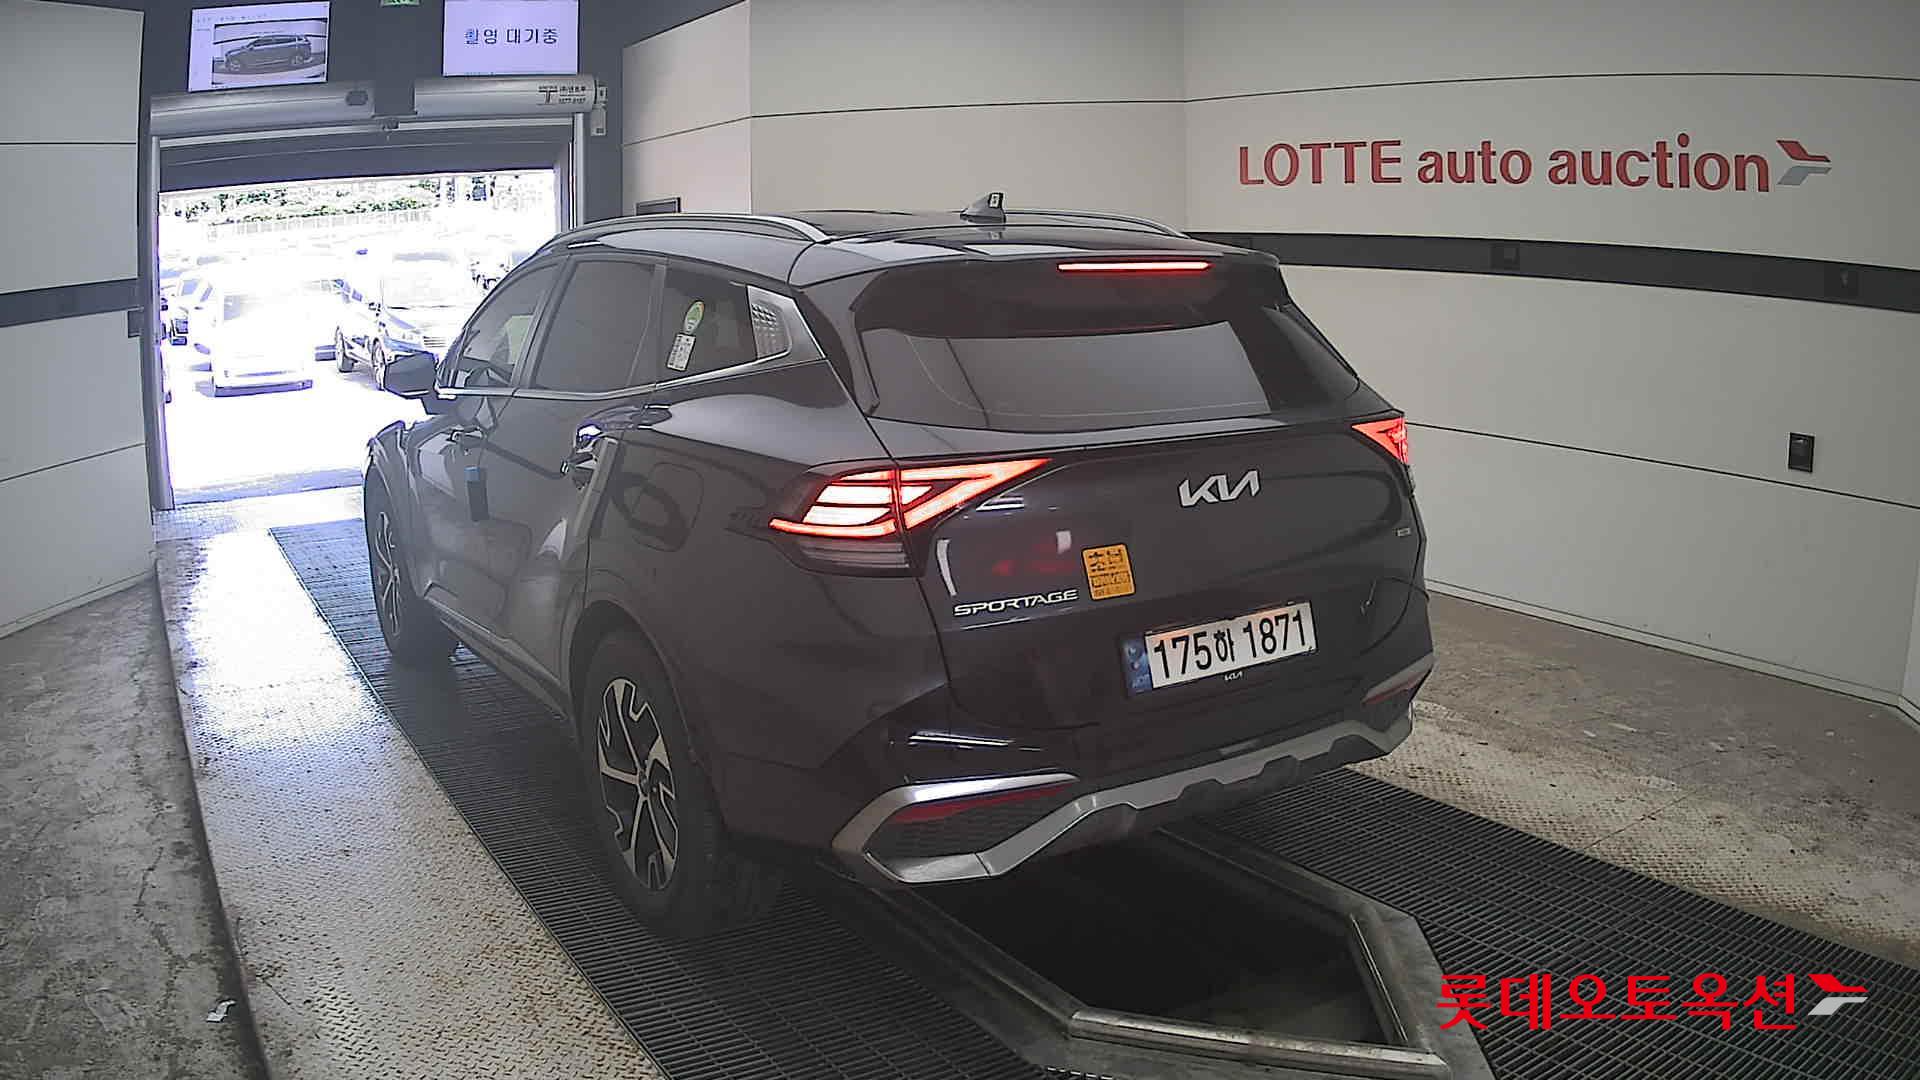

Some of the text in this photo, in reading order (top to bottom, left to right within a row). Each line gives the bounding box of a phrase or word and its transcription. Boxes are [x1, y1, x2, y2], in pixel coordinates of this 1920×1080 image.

[506, 28, 559, 45] 대기중
[1239, 132, 1770, 193] LOTTE auto auction
[1178, 469, 1261, 507] KIA
[953, 589, 1080, 617] SPORTAGE
[1154, 609, 1306, 679] 175하 1871
